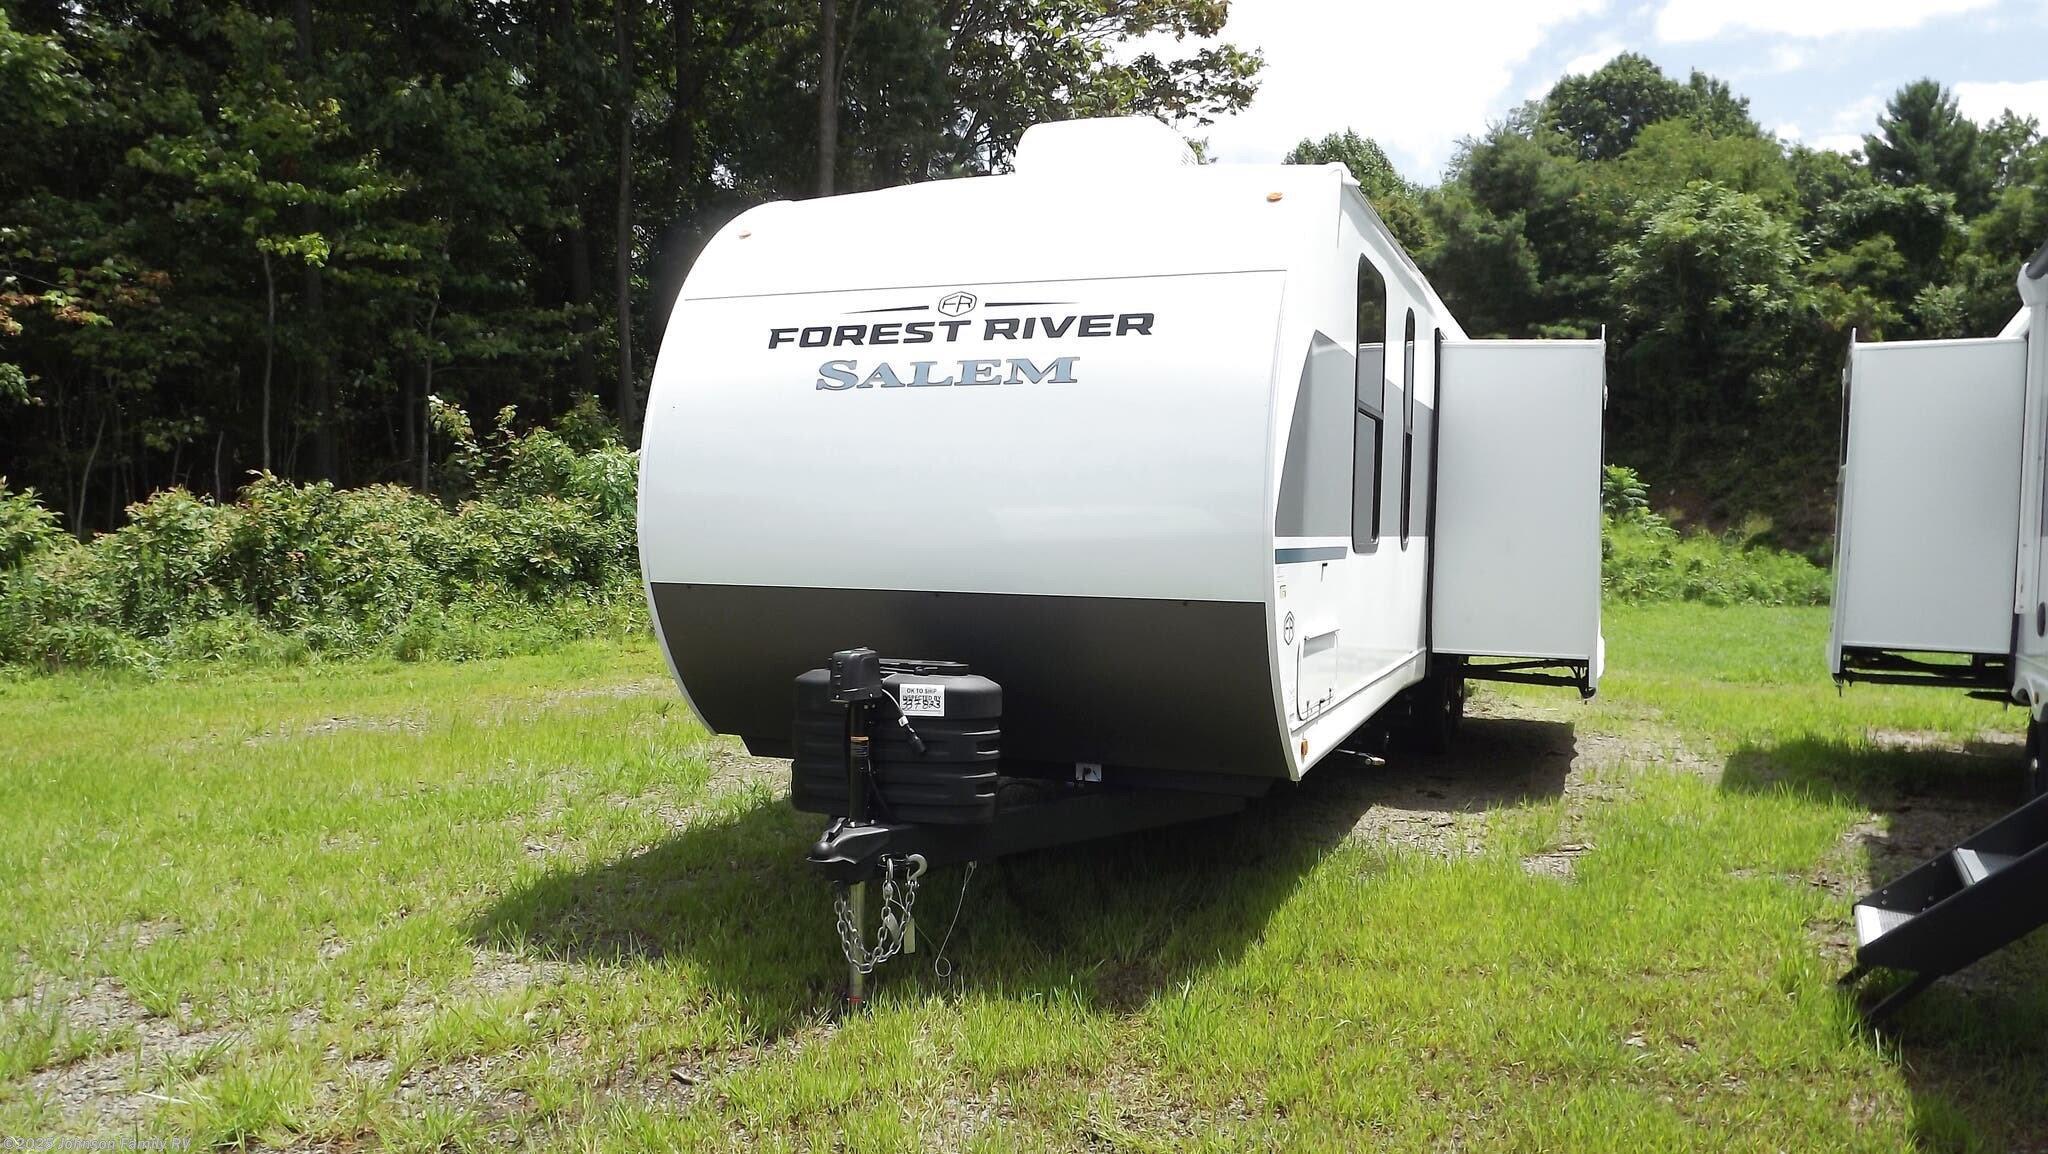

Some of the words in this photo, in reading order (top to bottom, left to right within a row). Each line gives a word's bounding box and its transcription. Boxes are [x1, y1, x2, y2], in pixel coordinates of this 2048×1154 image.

[768, 319, 971, 349] FOREST
[983, 313, 1154, 340] RIVER
[815, 356, 1080, 391] SALEM
